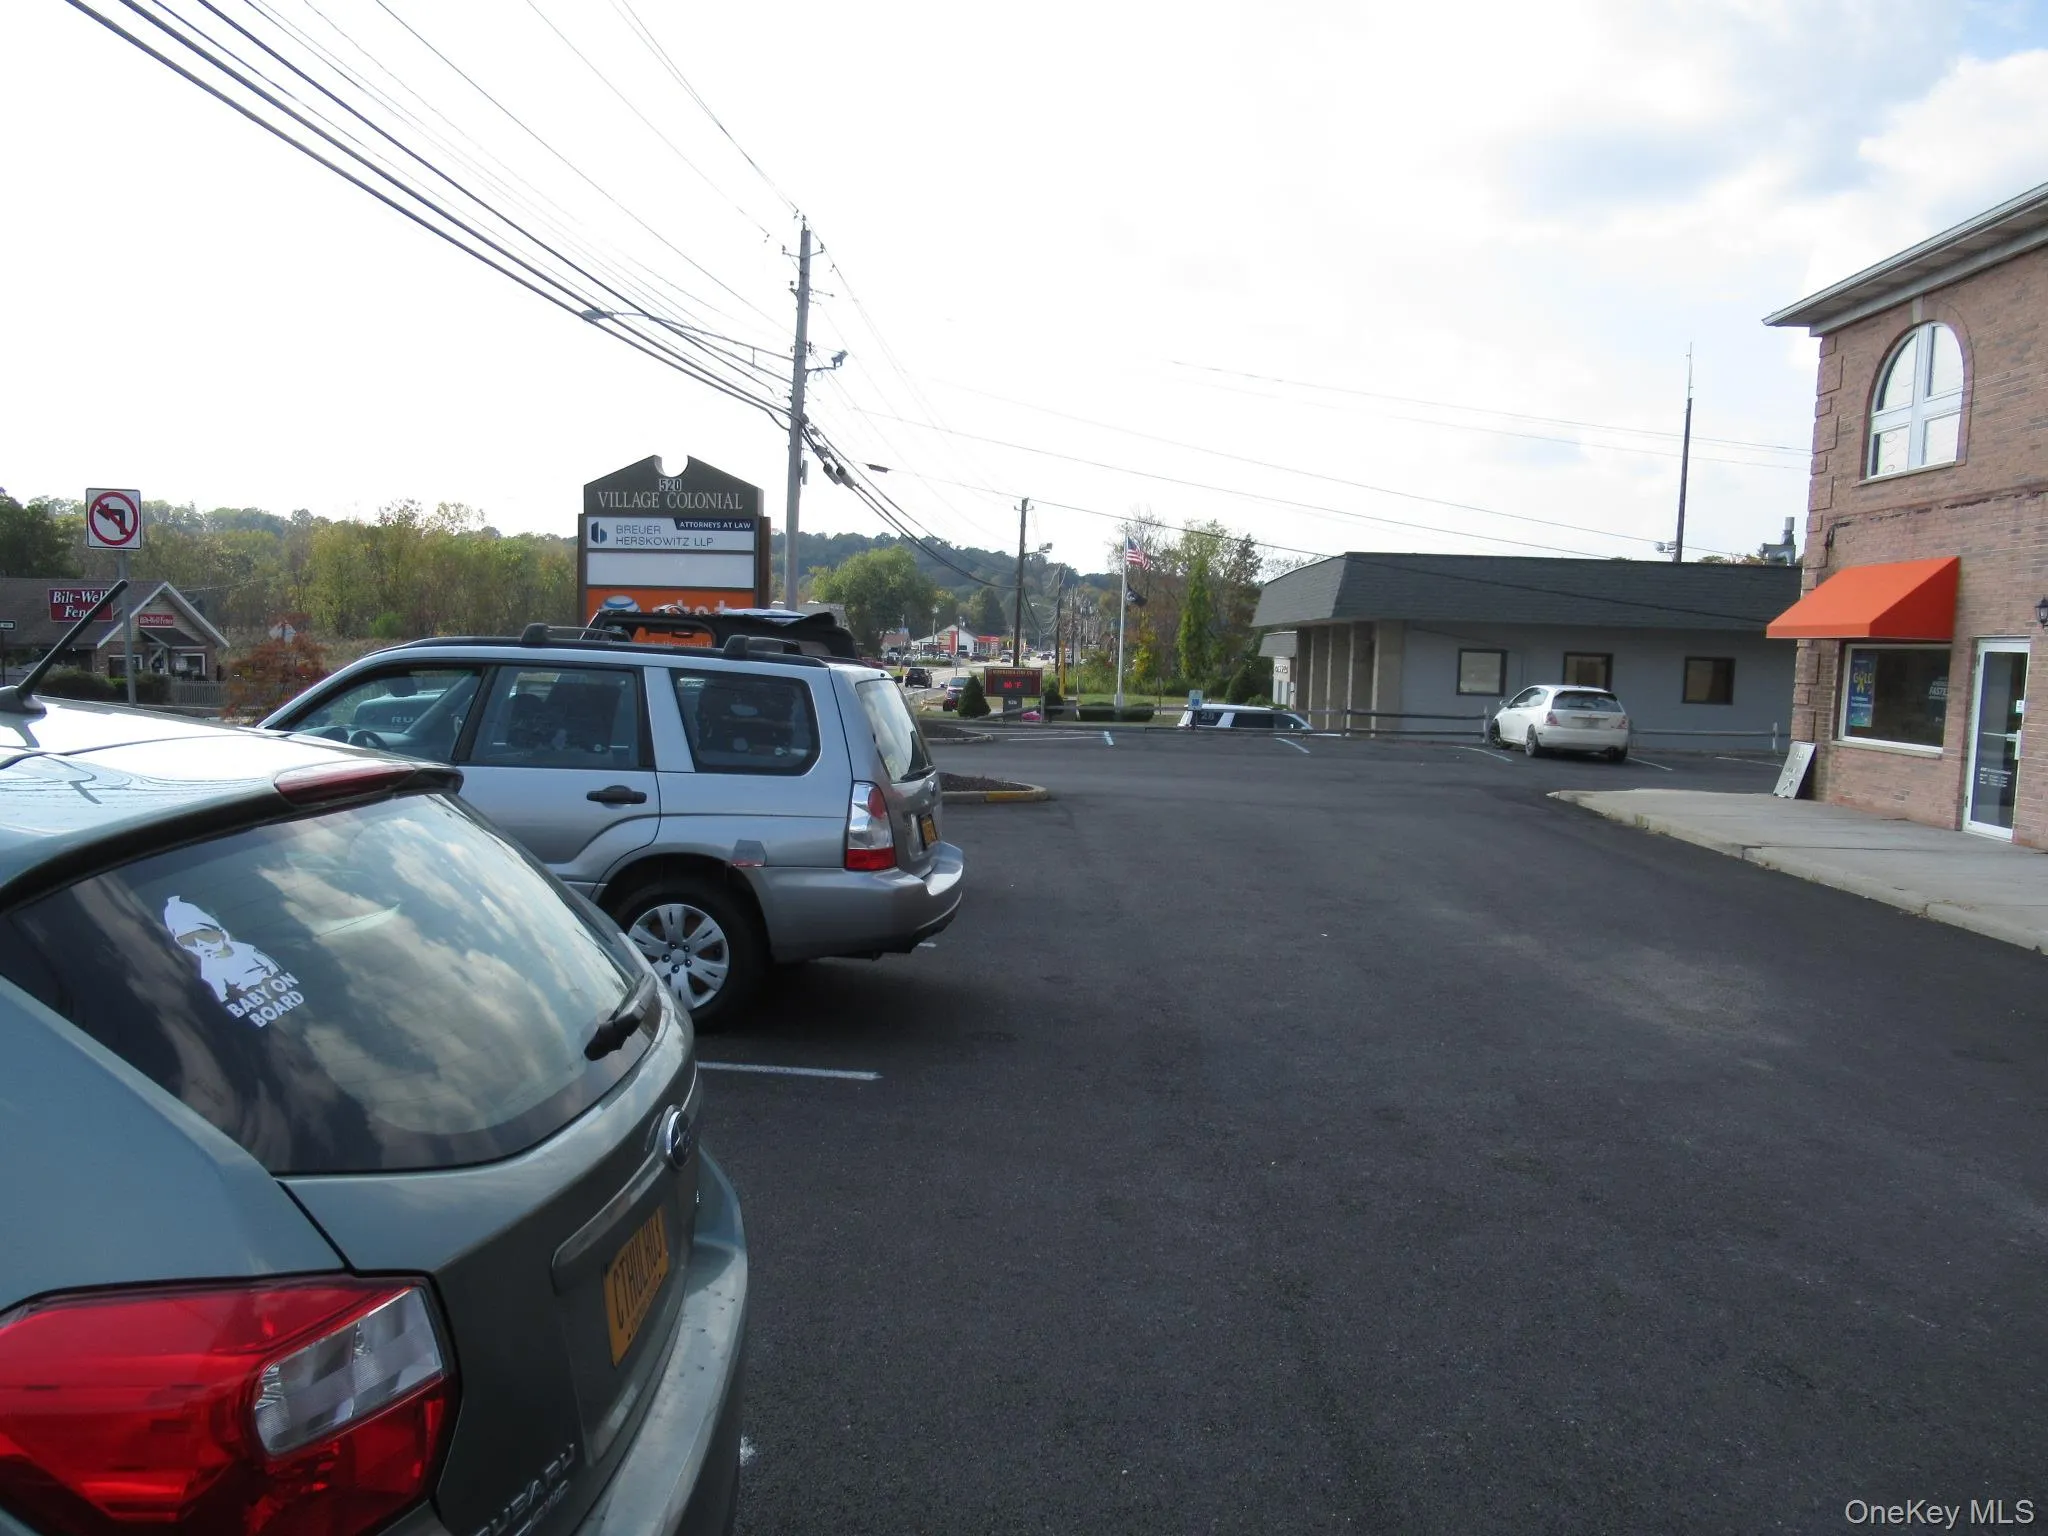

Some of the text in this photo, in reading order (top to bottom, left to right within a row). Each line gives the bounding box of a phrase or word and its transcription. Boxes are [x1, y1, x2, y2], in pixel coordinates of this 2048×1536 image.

[659, 479, 682, 491] 520
[598, 491, 743, 510] VILLAGE COLONIAL
[616, 524, 661, 535] BREUER
[680, 521, 721, 529] ATTORNEYS
[694, 538, 714, 547] LLP
[63, 605, 88, 618] Fen
[226, 972, 300, 1018] BABY ON
[249, 991, 305, 1028] BOARD
